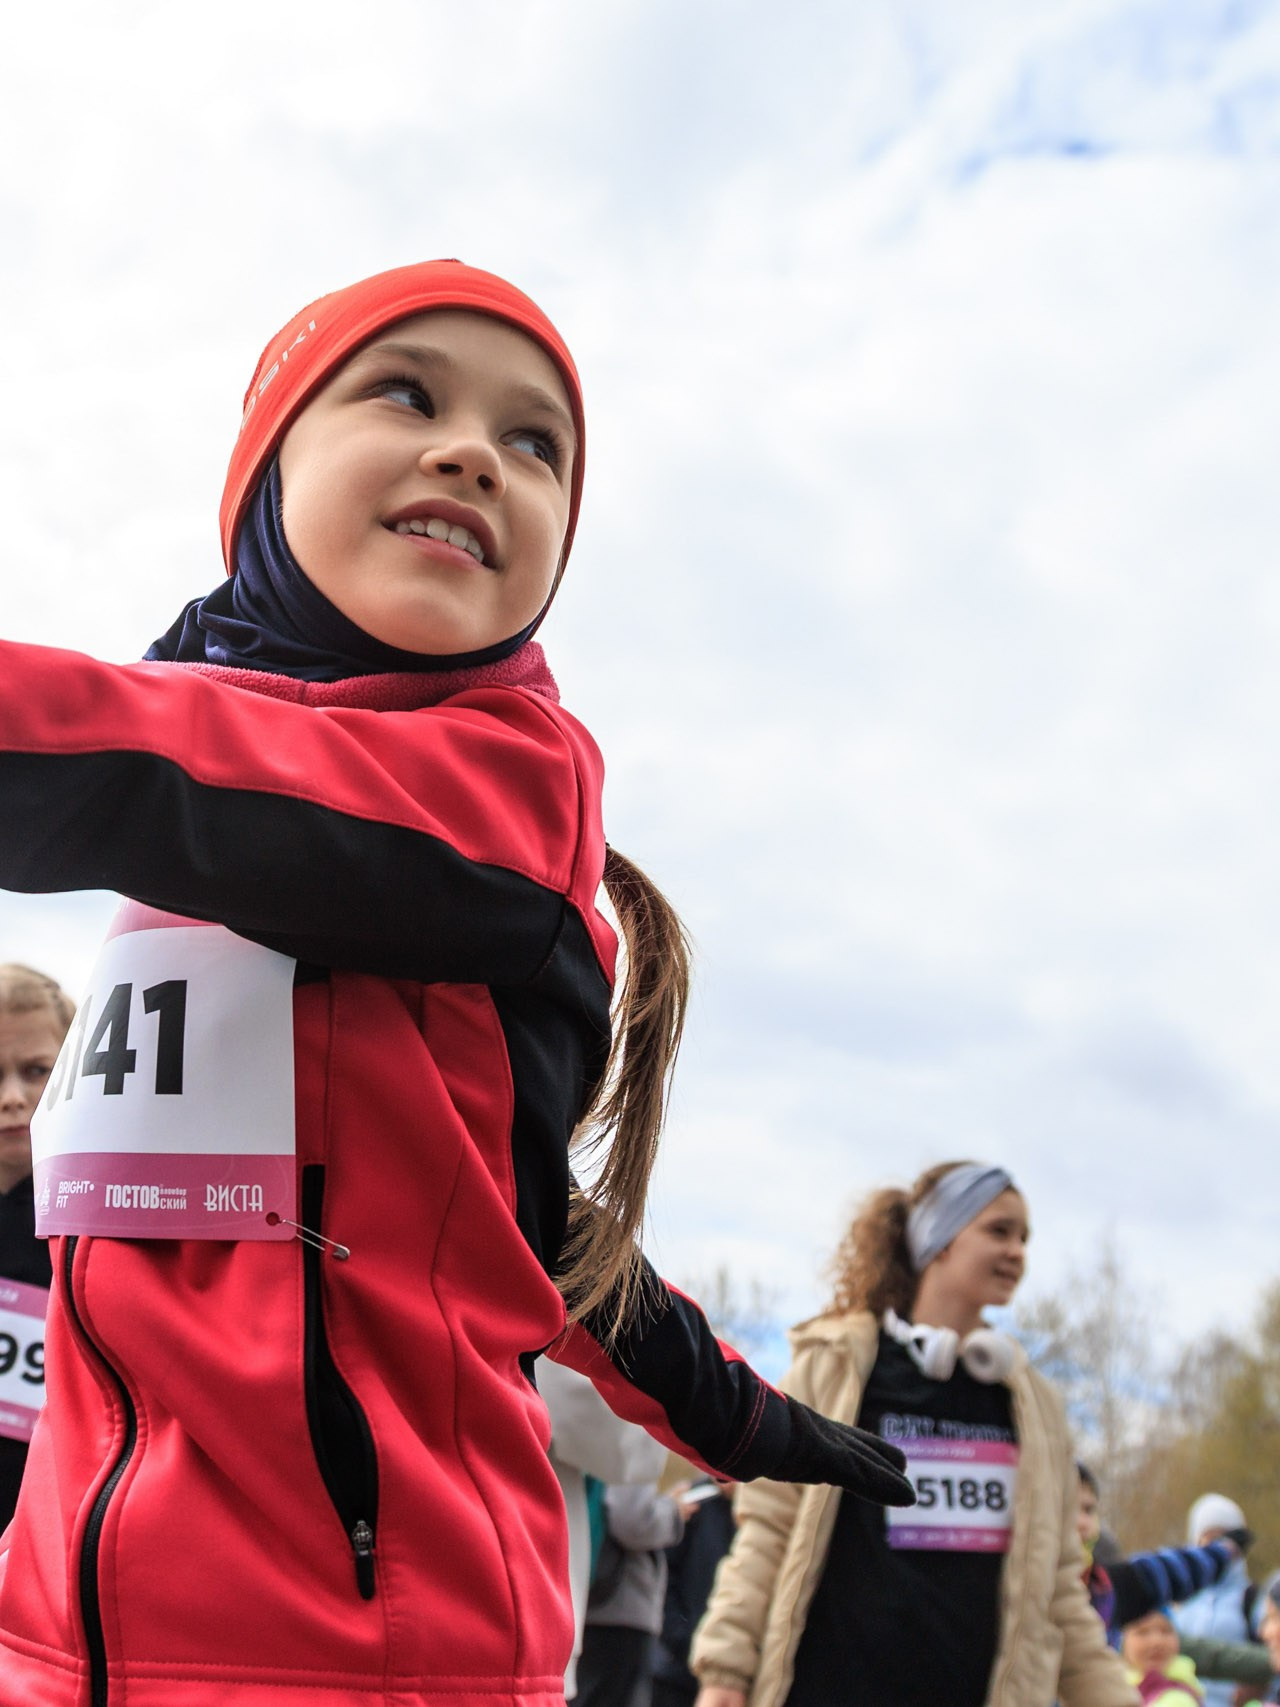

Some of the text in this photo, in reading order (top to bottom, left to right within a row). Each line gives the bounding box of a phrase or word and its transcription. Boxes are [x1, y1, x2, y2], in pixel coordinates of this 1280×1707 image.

[58, 1181, 90, 1194] BRIGHT
[56, 1195, 69, 1208] FIT
[203, 1184, 263, 1212] ВИСТА
[916, 1477, 1007, 1512] 5188
